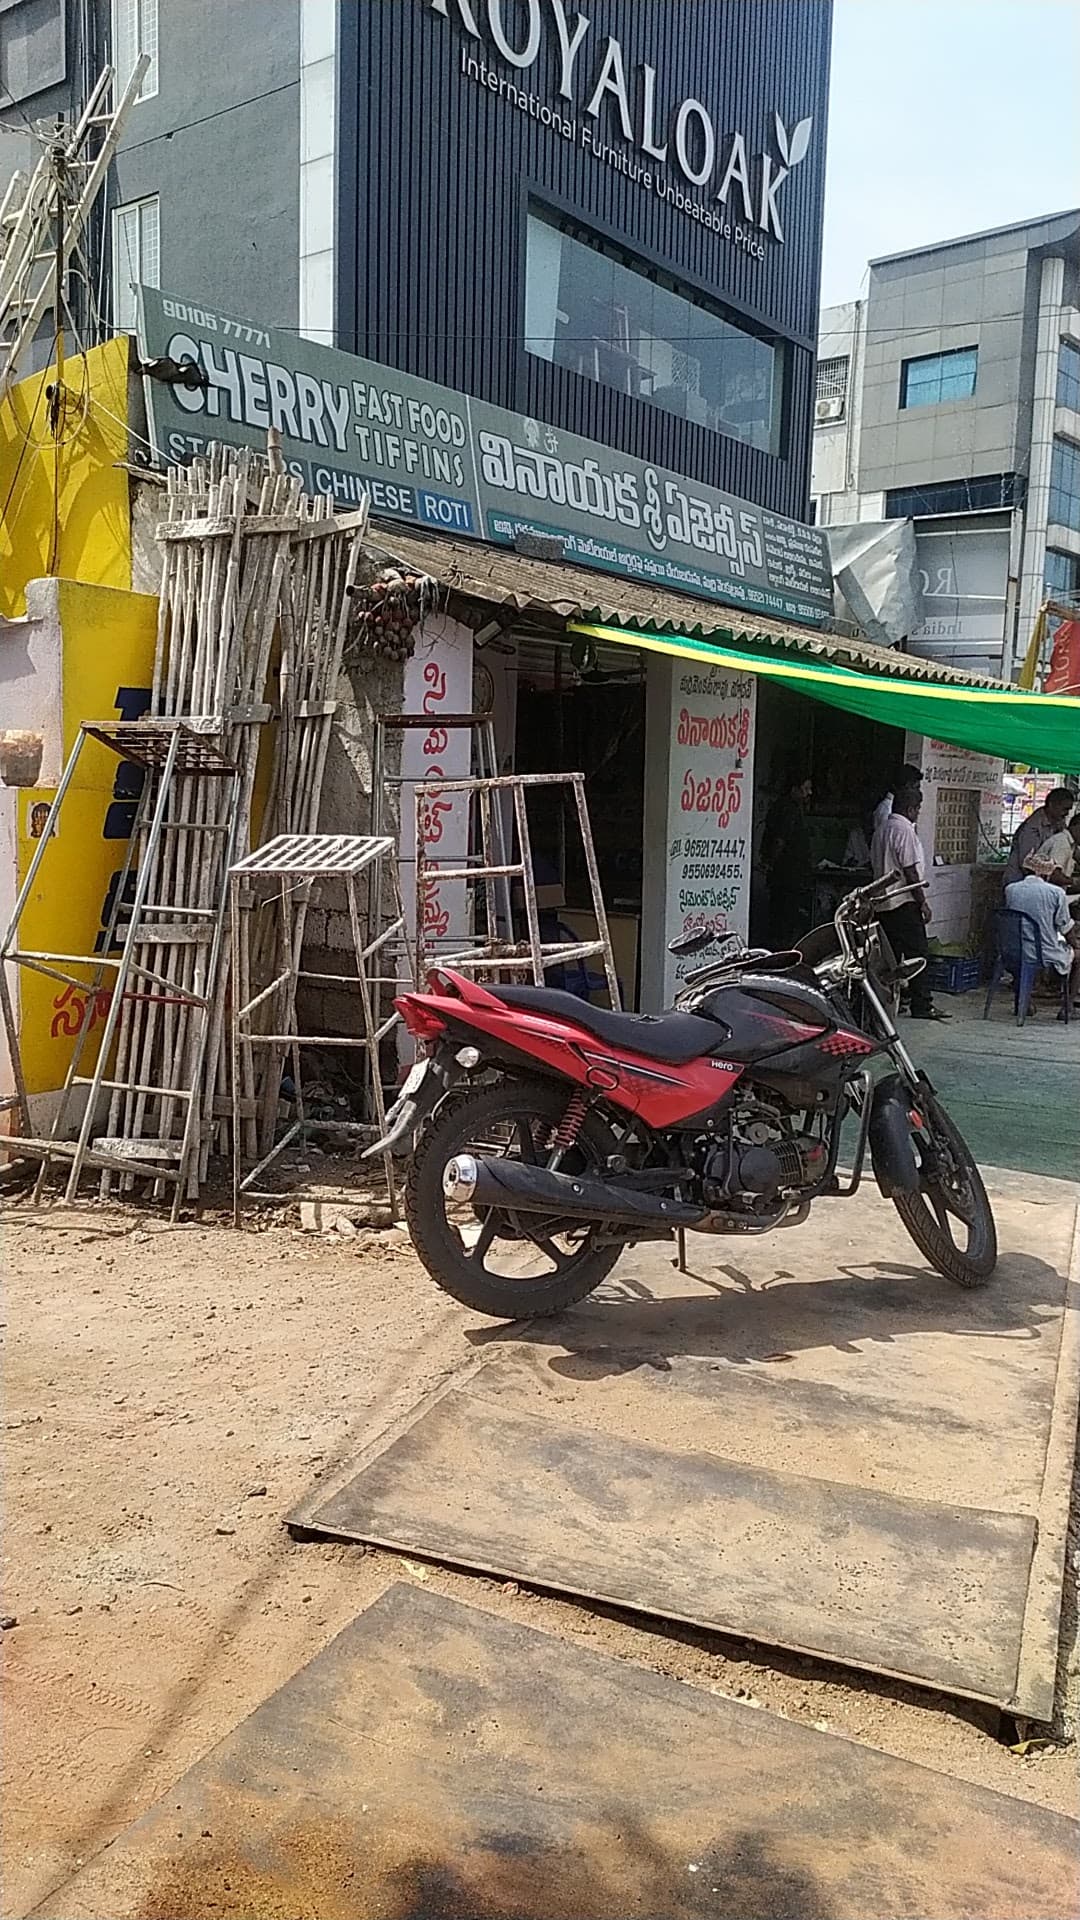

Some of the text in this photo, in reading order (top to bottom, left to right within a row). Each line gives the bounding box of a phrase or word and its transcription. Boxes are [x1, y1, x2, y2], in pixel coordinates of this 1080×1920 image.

[462, 47, 765, 261] International Furniture Unbeatable Price
[162, 299, 272, 349] 90105 77771
[167, 331, 351, 452] CHERRY
[352, 380, 466, 448] FAST FOOD
[354, 425, 465, 487] TIFFINS
[478, 429, 641, 531] వినాయక
[315, 469, 415, 515] CHINESE
[423, 497, 469, 528] ROTI
